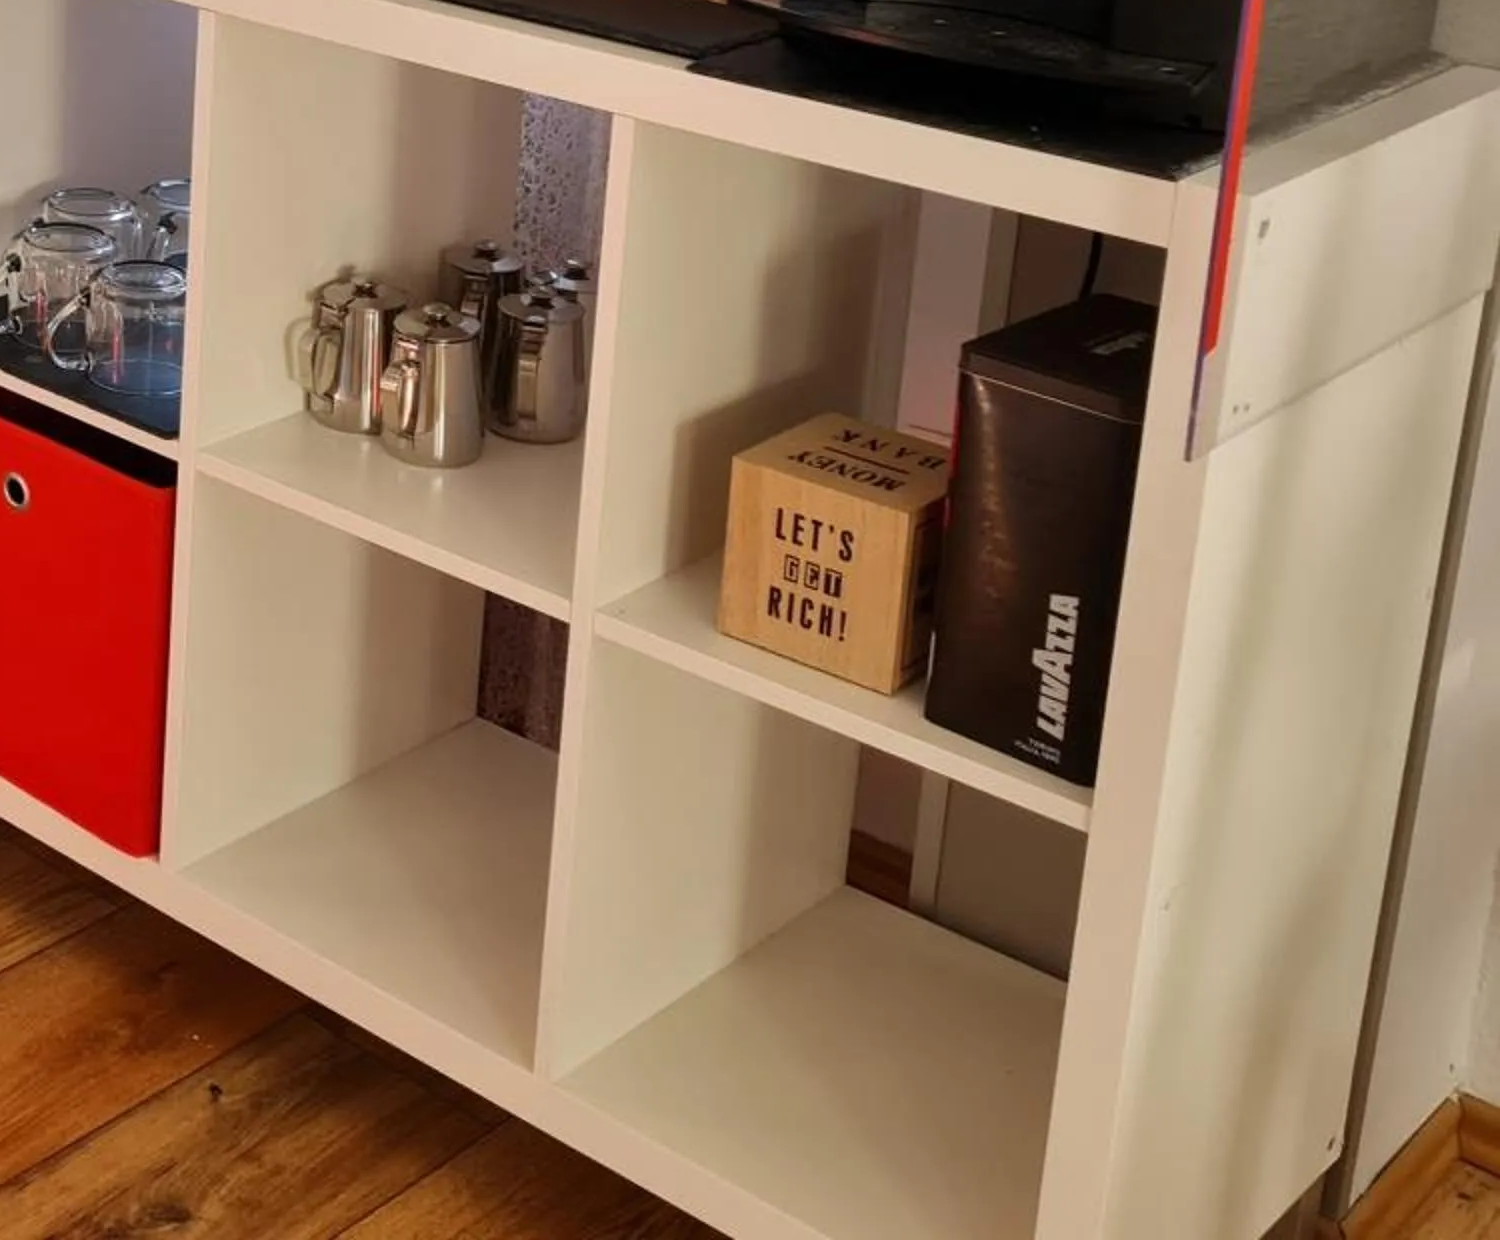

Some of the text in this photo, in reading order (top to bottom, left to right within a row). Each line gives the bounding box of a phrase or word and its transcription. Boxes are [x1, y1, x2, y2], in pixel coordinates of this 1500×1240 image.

[788, 451, 906, 491] MONEY
[775, 507, 854, 563] LET'S
[767, 585, 847, 642] RICH!
[1032, 593, 1080, 742] LAVAZZA
